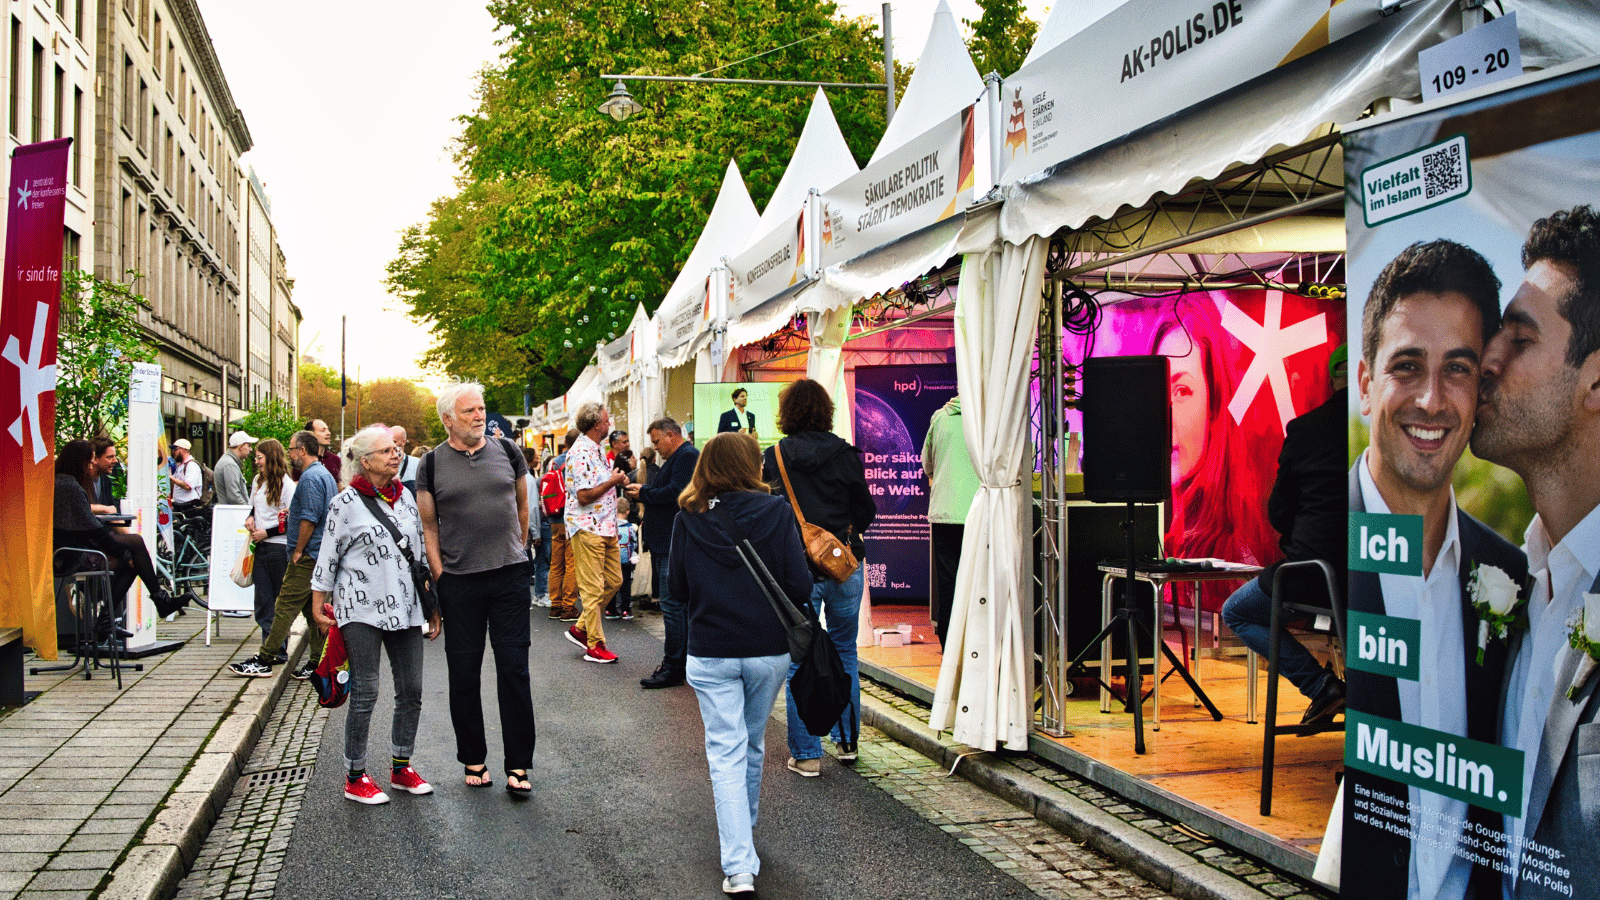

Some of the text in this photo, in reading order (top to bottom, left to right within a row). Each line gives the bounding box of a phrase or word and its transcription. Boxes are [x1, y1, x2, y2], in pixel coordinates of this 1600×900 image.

[1120, 0, 1244, 83] AK-POLIS.DE
[1432, 65, 1466, 94] 109
[1484, 48, 1510, 74] 20
[1032, 90, 1046, 105] VIELE
[1032, 99, 1054, 118] STÄRKEN
[865, 150, 939, 207] SÄKULARE POLITIK
[1367, 166, 1421, 195] Vielfalt
[857, 203, 889, 232] STÄRKT
[890, 175, 944, 219] DEMOKRATIE
[1370, 186, 1422, 211] im Islam
[26, 265, 45, 281] sind
[47, 265, 58, 281] fre
[894, 380, 916, 393] hpd
[865, 452, 923, 463] Der säku
[865, 468, 923, 479] Blick auf
[888, 484, 924, 496] Welt.
[1360, 526, 1409, 563] Ich
[1359, 625, 1408, 667] bin
[1356, 722, 1508, 802] Muslim.
[1354, 799, 1570, 879] und Sozialwerks, der Ibn Rushd-Goethe Moschee
[1355, 783, 1370, 797] Eine
[1372, 789, 1404, 808] Initiative
[1406, 801, 1421, 814] des
[1475, 823, 1513, 843] Gouges
[1515, 835, 1565, 859] Bildungs-
[1354, 812, 1573, 897] und des Arbeitskreises Politischer Islam (AK Polis)
